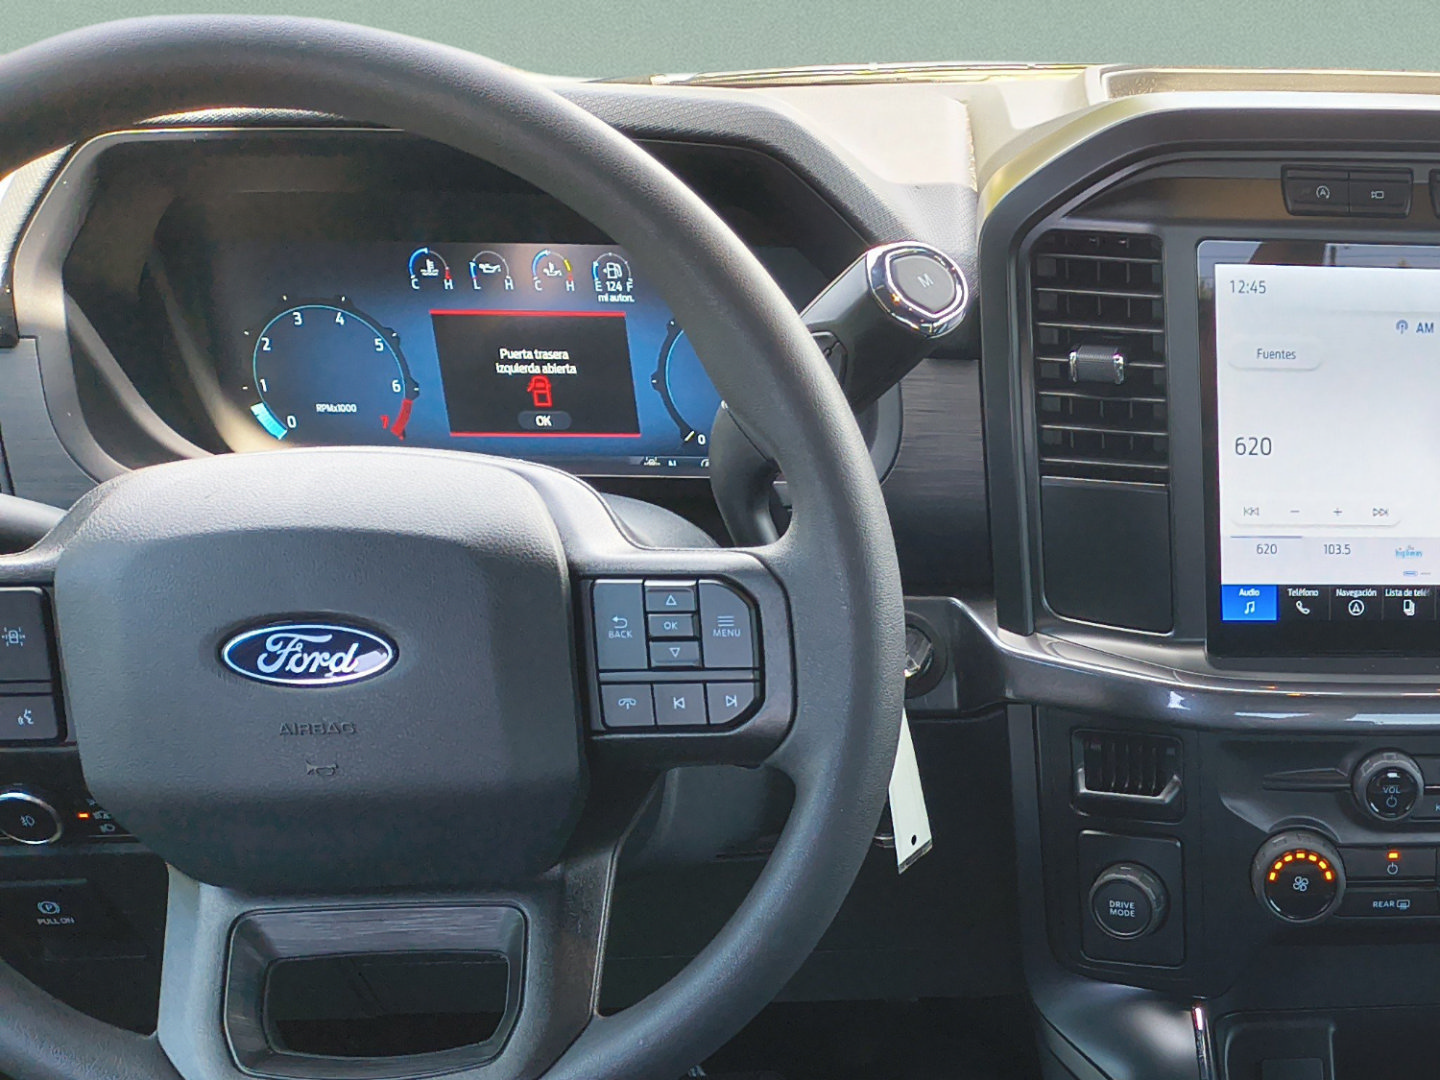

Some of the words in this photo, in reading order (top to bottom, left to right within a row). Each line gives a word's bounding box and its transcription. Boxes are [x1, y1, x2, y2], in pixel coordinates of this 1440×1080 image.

[410, 279, 420, 290] C
[444, 279, 453, 290] H
[474, 279, 481, 290] L
[504, 279, 514, 290] H
[534, 280, 543, 291] C
[565, 280, 575, 291] H
[595, 281, 603, 292] E
[605, 280, 623, 291] 124
[626, 281, 633, 292] F
[1229, 280, 1267, 294] 12:45
[292, 311, 303, 326] 3
[335, 311, 345, 326] 4
[1415, 322, 1435, 334] AM
[261, 337, 271, 351] 2
[374, 338, 384, 352] 5
[499, 348, 533, 359] Puerta
[534, 348, 569, 360] trasera
[1256, 348, 1297, 360] Fuentes
[541, 362, 577, 374] abierta
[259, 378, 267, 392] 1
[391, 380, 401, 393] 6
[287, 415, 297, 428] 0
[380, 414, 389, 429] 7
[535, 415, 552, 426] OK
[697, 434, 706, 445] 0
[1234, 436, 1272, 456] 620
[1256, 544, 1278, 555] 620
[1323, 544, 1351, 555] 103.5
[1239, 588, 1260, 597] Audio
[1287, 588, 1319, 597] Teléfono
[1335, 588, 1377, 598] Navegación
[1385, 588, 1403, 597] Lista
[1403, 588, 1413, 597] de
[663, 621, 678, 630] OK
[608, 630, 633, 639] BACK
[712, 628, 741, 637] MENU
[256, 633, 359, 678] Ford
[279, 722, 357, 736] AIRBAG
[1109, 900, 1135, 909] DRIVE
[1372, 900, 1395, 908] REAR
[1109, 908, 1136, 917] MODE
